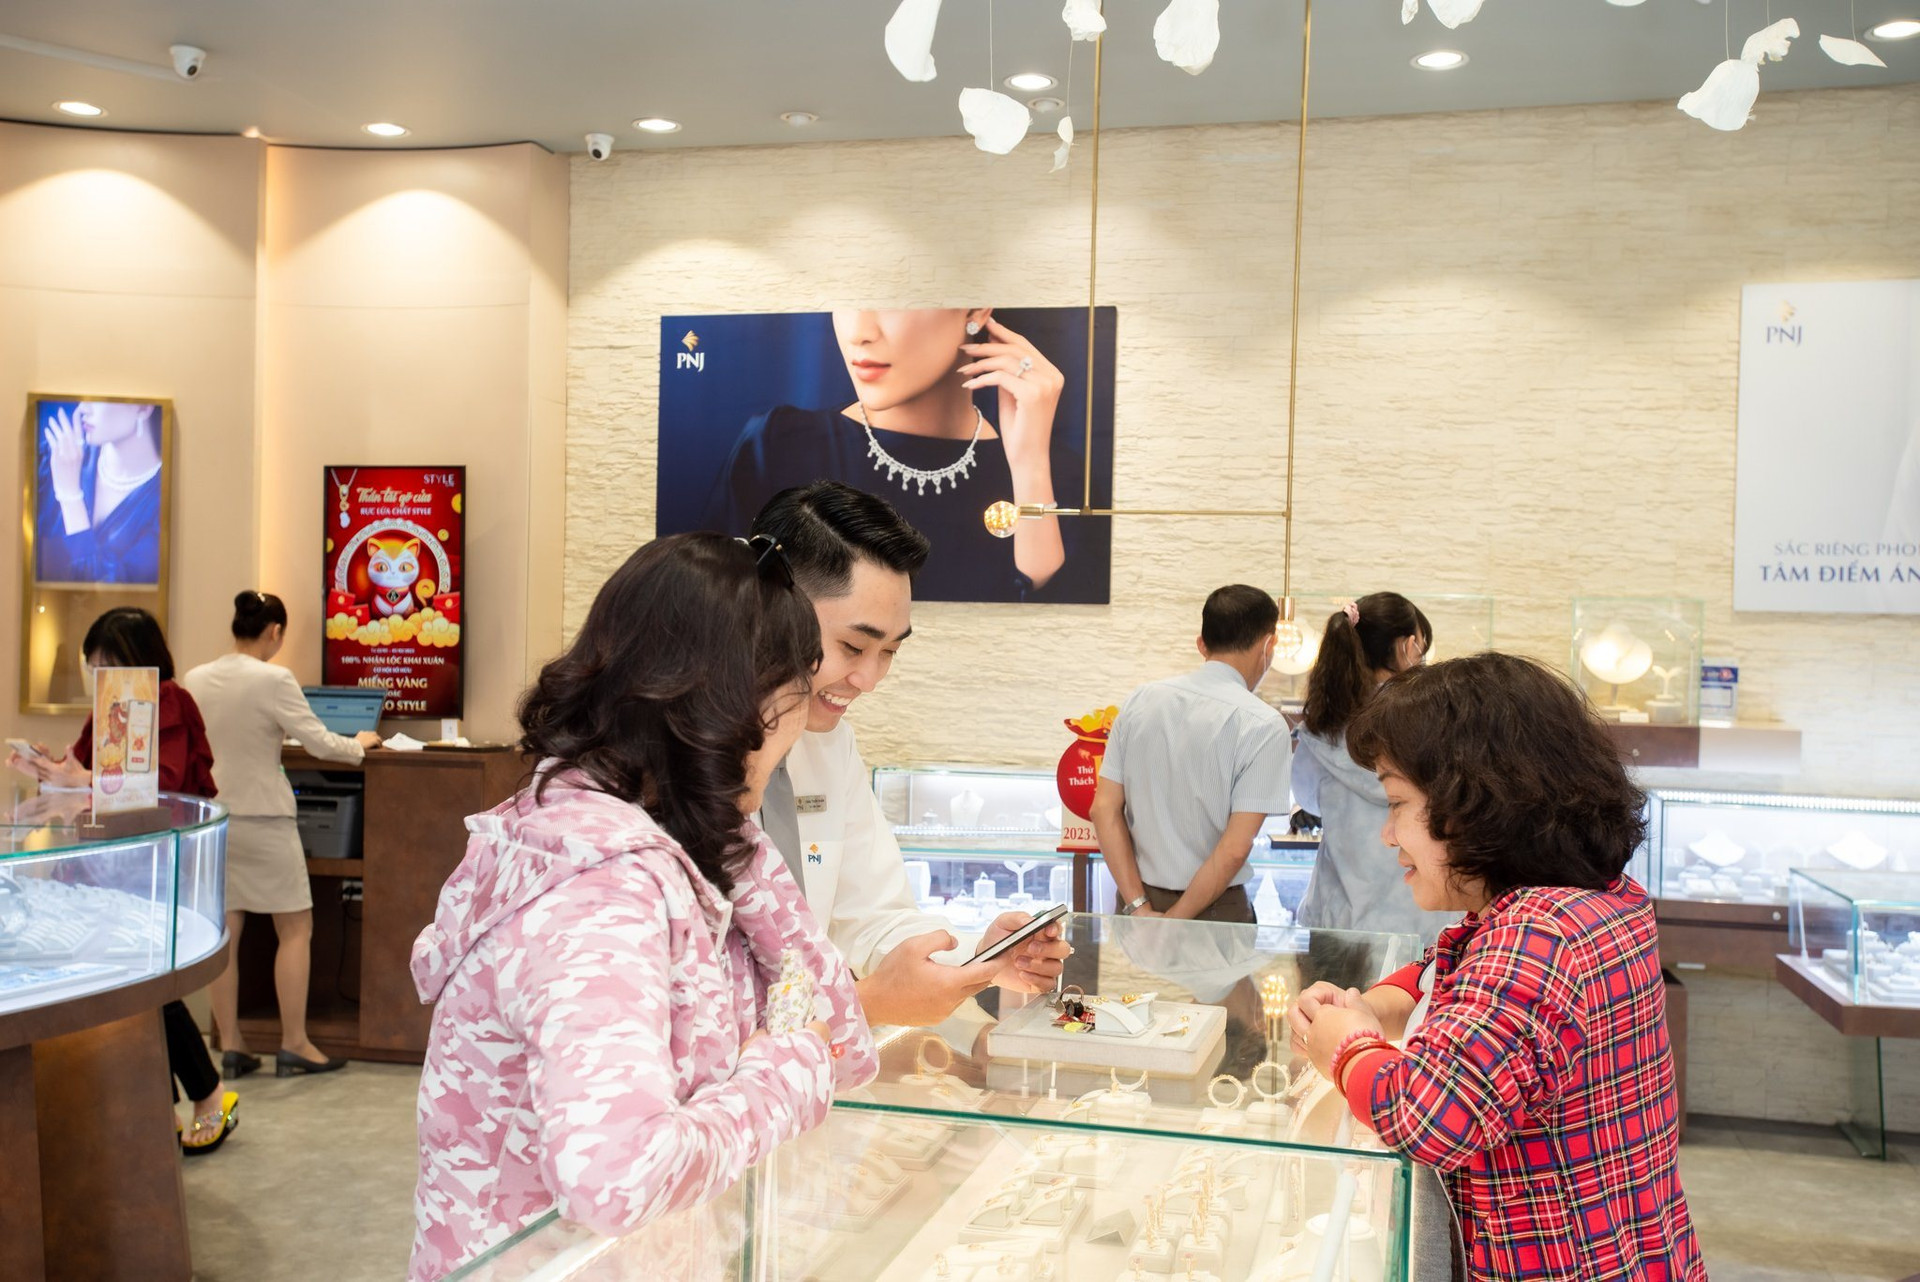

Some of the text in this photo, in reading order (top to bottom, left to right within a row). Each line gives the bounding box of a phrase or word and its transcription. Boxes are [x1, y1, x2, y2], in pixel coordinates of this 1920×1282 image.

[1766, 325, 1802, 346] PNJ
[676, 352, 705, 372] PNJ
[423, 473, 455, 485] STYLE
[412, 507, 431, 515] STYLE
[1814, 541, 1869, 556] RIÊNG
[1876, 542, 1920, 556] PHO
[1759, 561, 1809, 582] TÂM
[403, 656, 421, 665] KHAI
[423, 655, 445, 665] XUÂN
[358, 674, 428, 688] MIẾNG VÀNG
[397, 700, 427, 711] STYLE
[1077, 765, 1094, 775] Thử
[1068, 776, 1095, 786] Thách
[1063, 827, 1091, 840] 2023
[808, 854, 822, 864] PNJ
